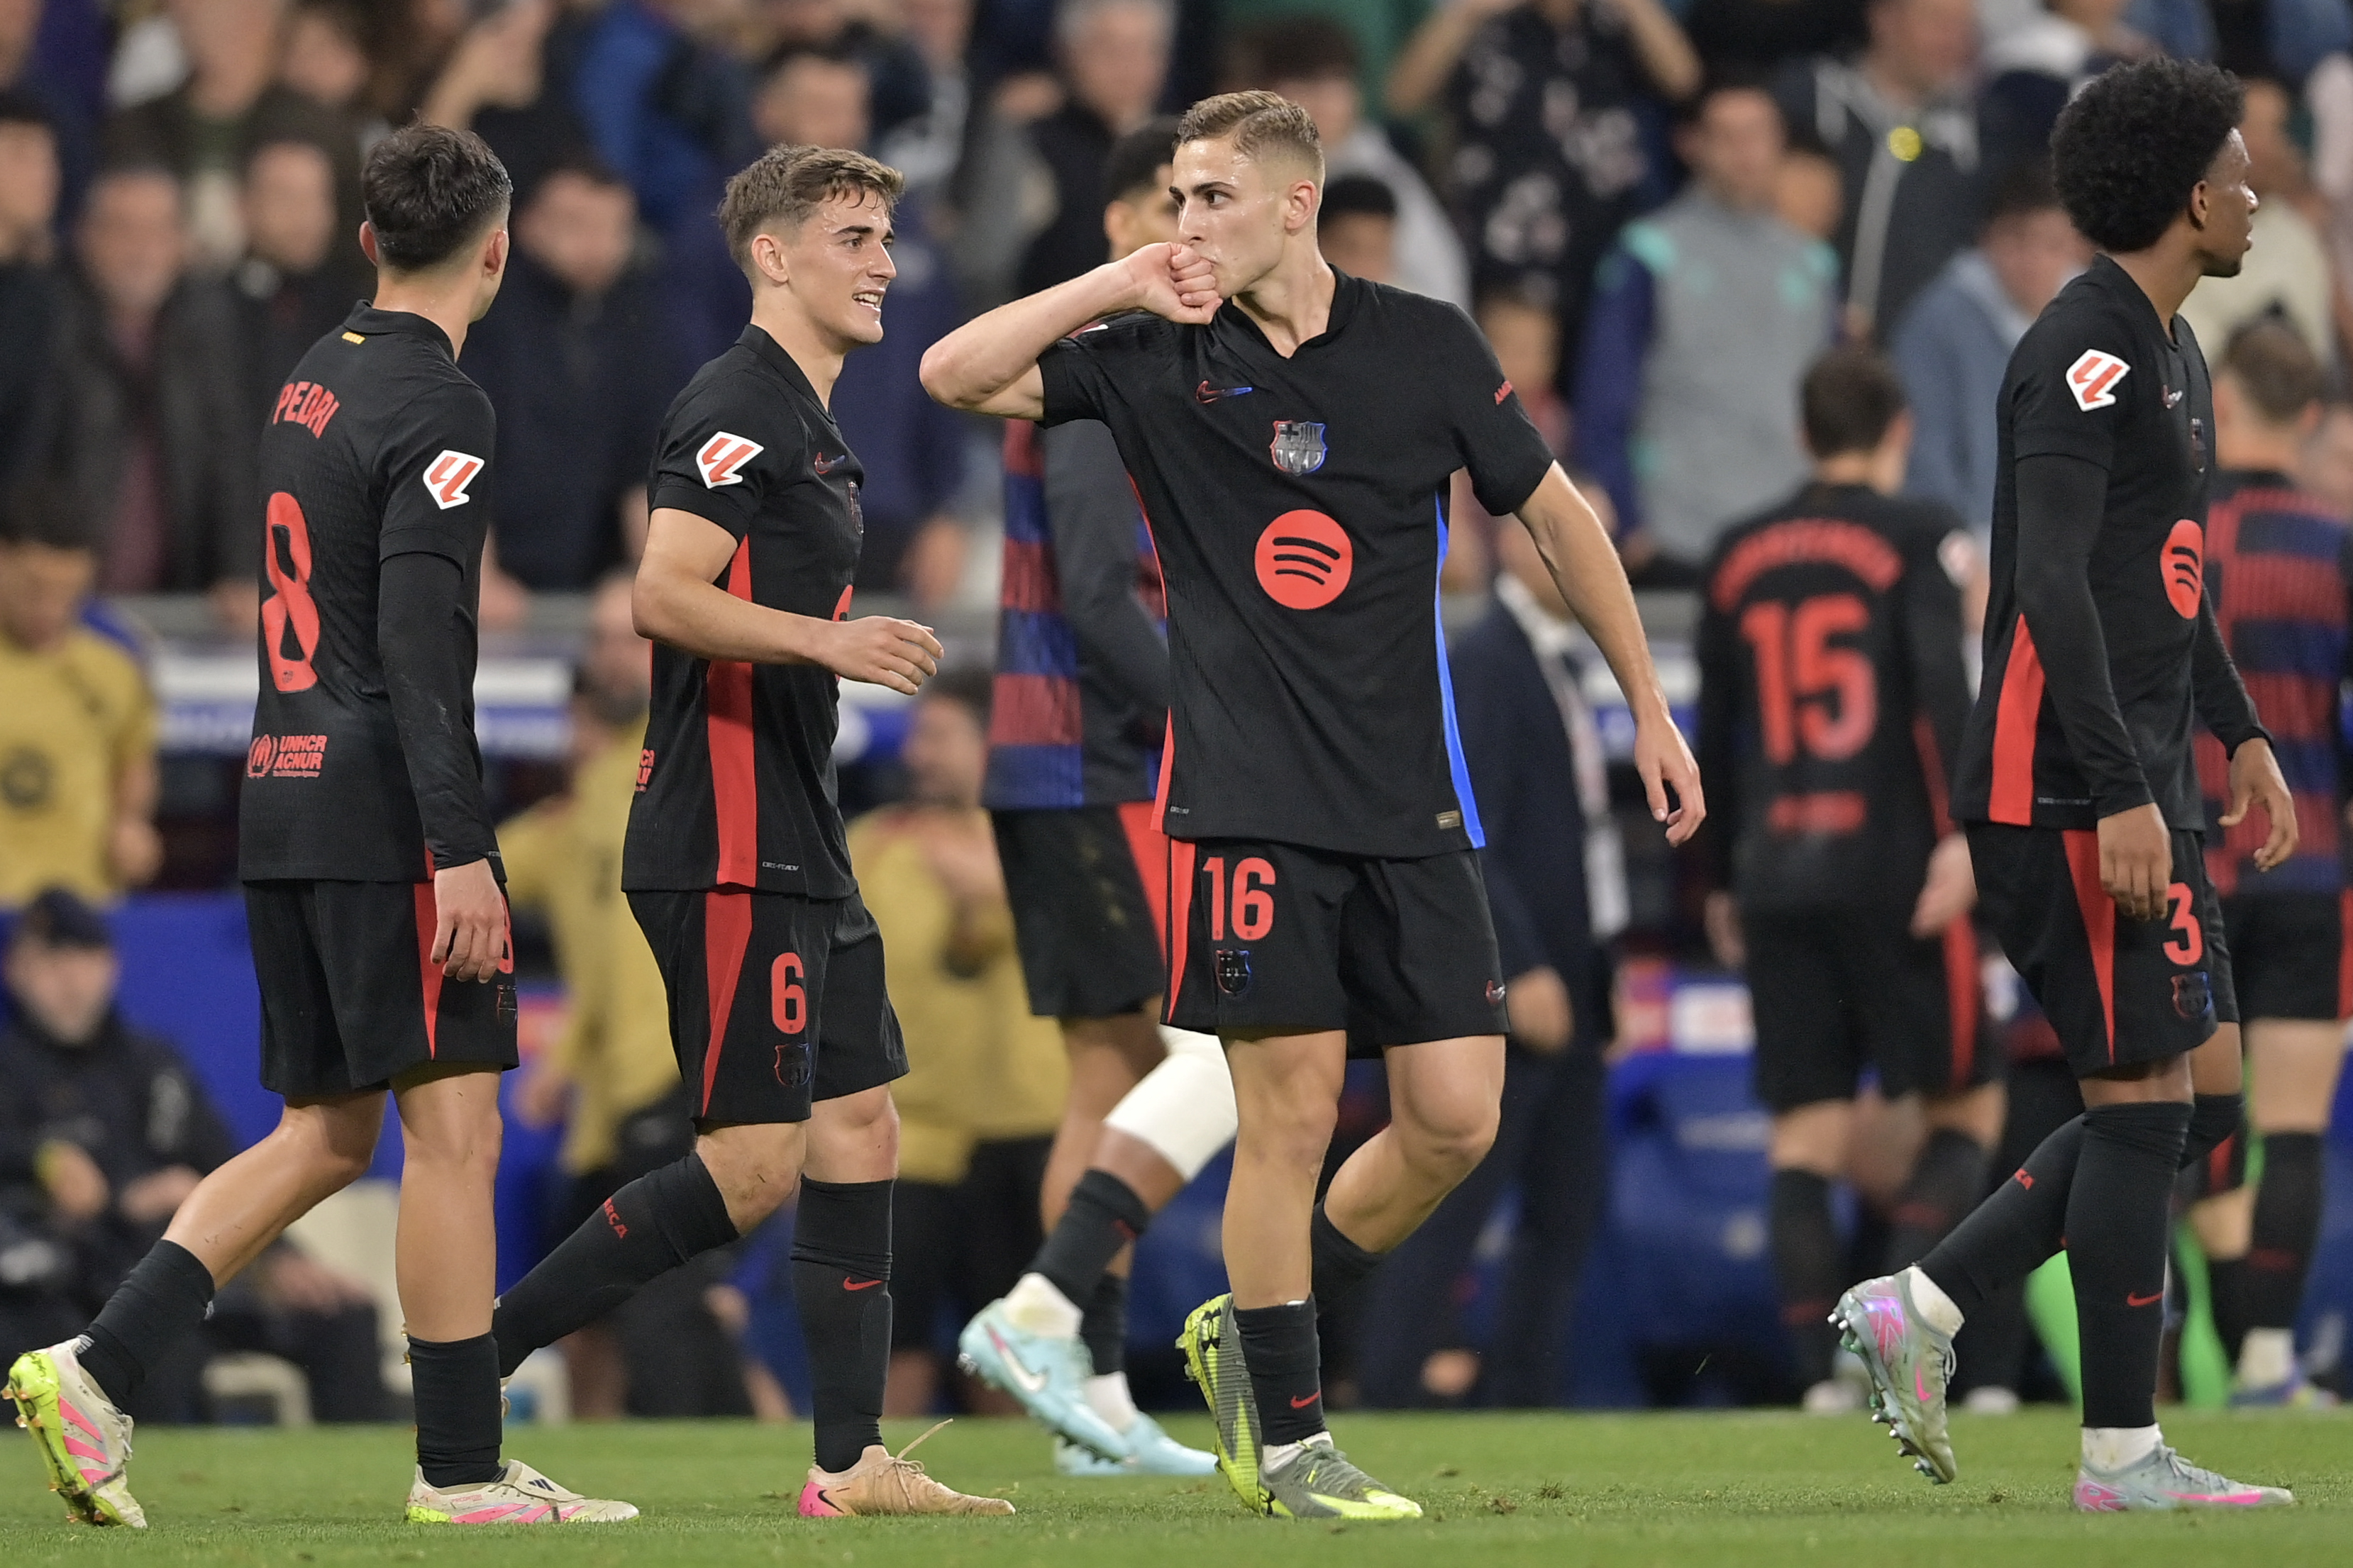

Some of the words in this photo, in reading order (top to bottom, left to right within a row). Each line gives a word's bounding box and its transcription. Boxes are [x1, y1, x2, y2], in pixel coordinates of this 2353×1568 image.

[272, 381, 340, 438] PEDRI
[262, 491, 321, 693] 8
[1740, 593, 1880, 767] 15
[274, 752, 323, 769] ACNUR
[279, 735, 327, 752] UNHCR
[1202, 857, 1276, 940] 16
[2163, 882, 2203, 966] 3
[771, 952, 807, 1035] 6
